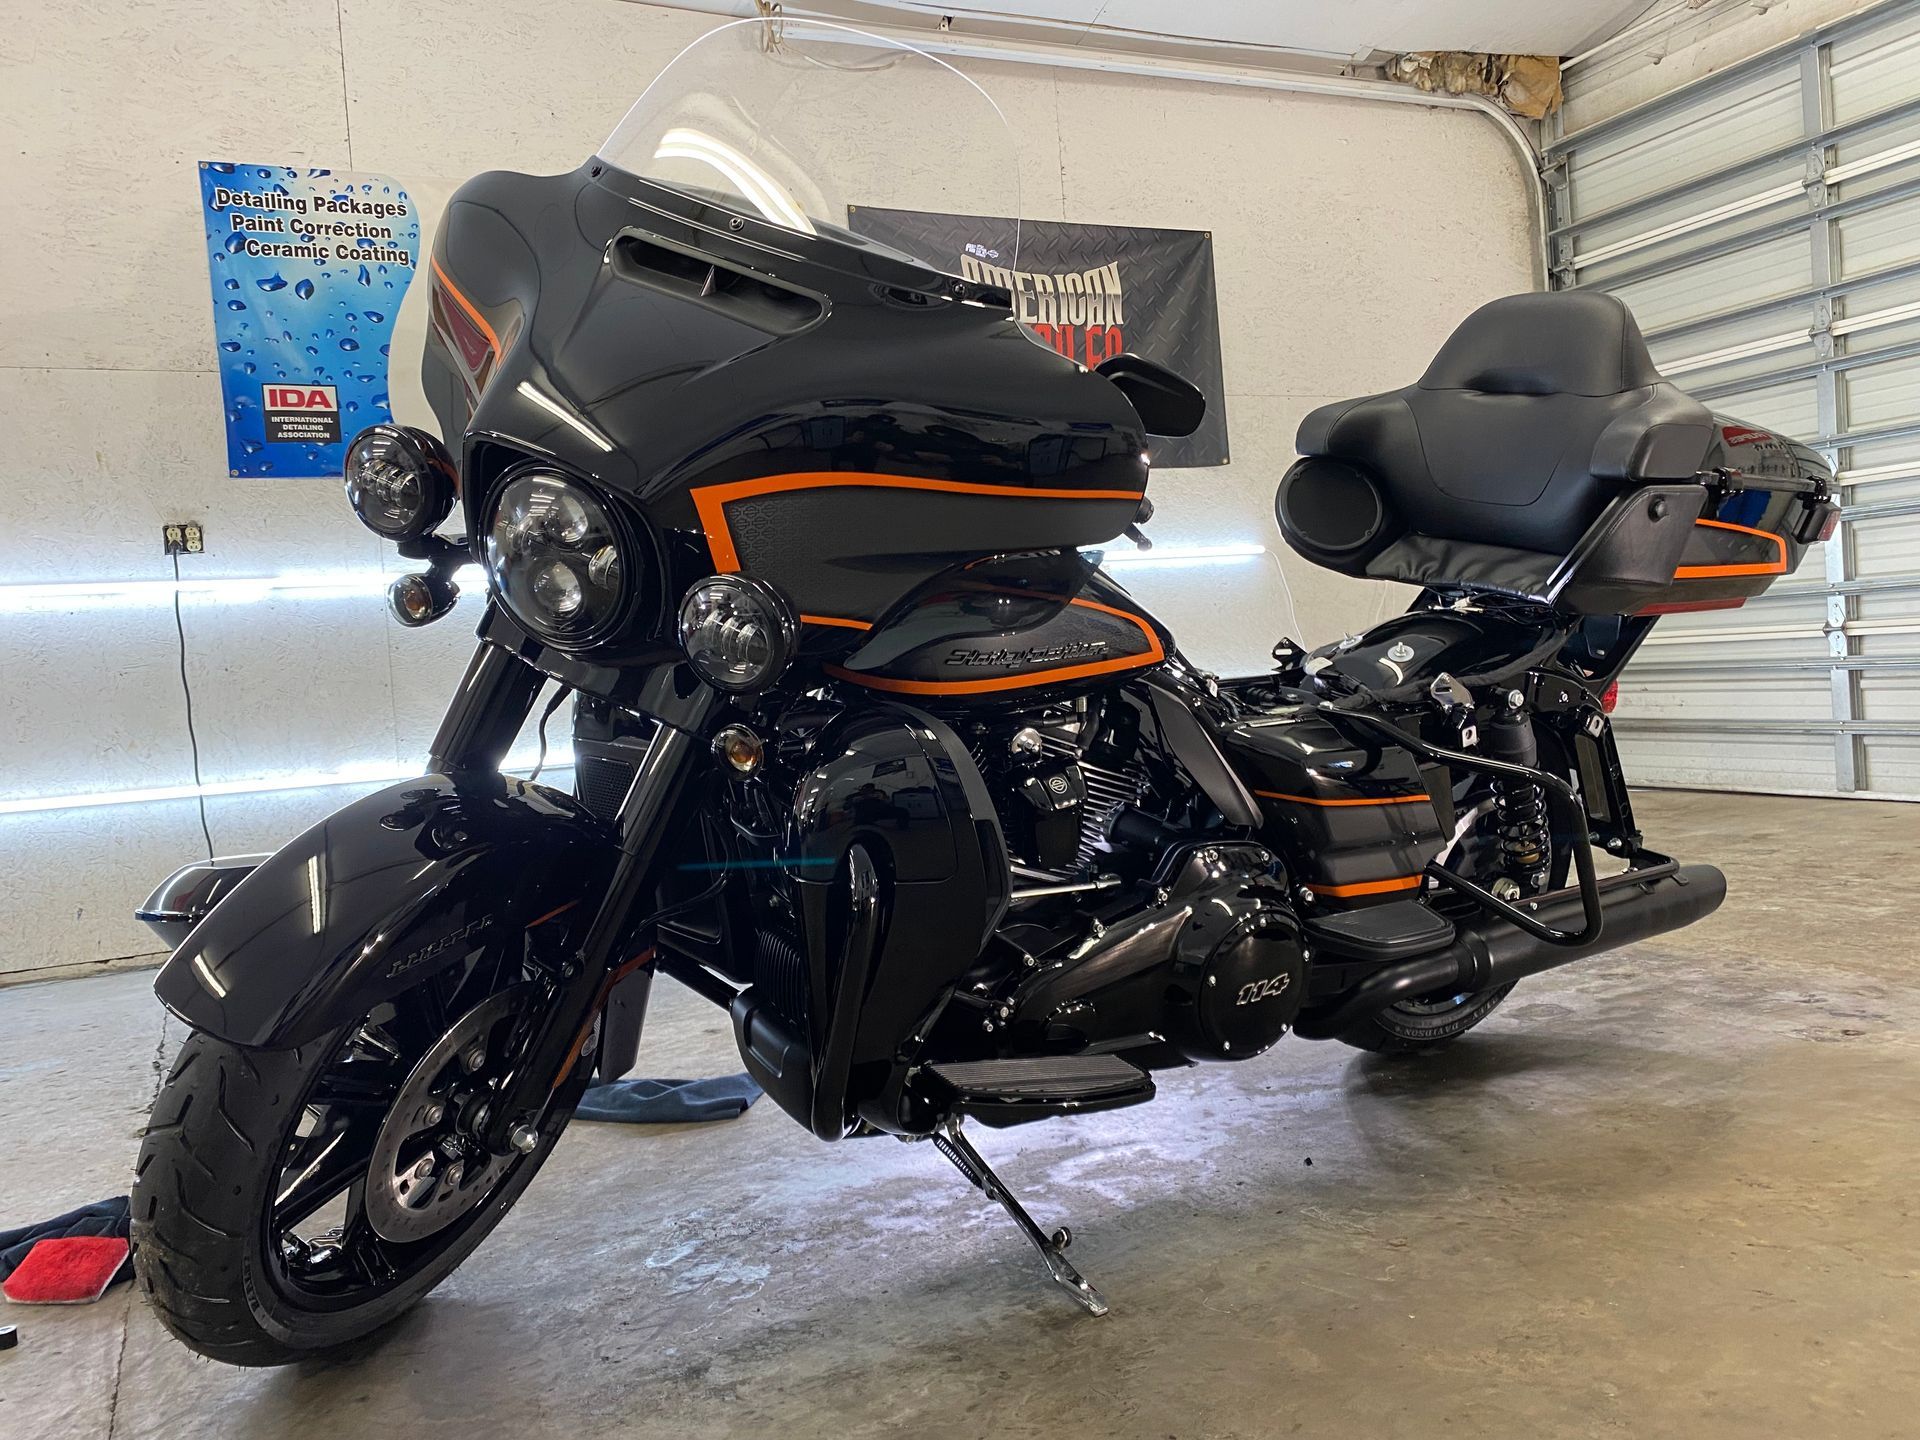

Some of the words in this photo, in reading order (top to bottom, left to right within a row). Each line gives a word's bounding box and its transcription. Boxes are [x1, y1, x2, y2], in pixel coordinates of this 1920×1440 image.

[217, 189, 307, 213] Detailing
[313, 196, 407, 219] Packages
[231, 214, 284, 233] Paint
[290, 218, 392, 239] Correction
[246, 239, 330, 260] Ceramic
[336, 244, 410, 266] Coating
[268, 388, 333, 408] IDA
[1236, 973, 1290, 1006] 114
